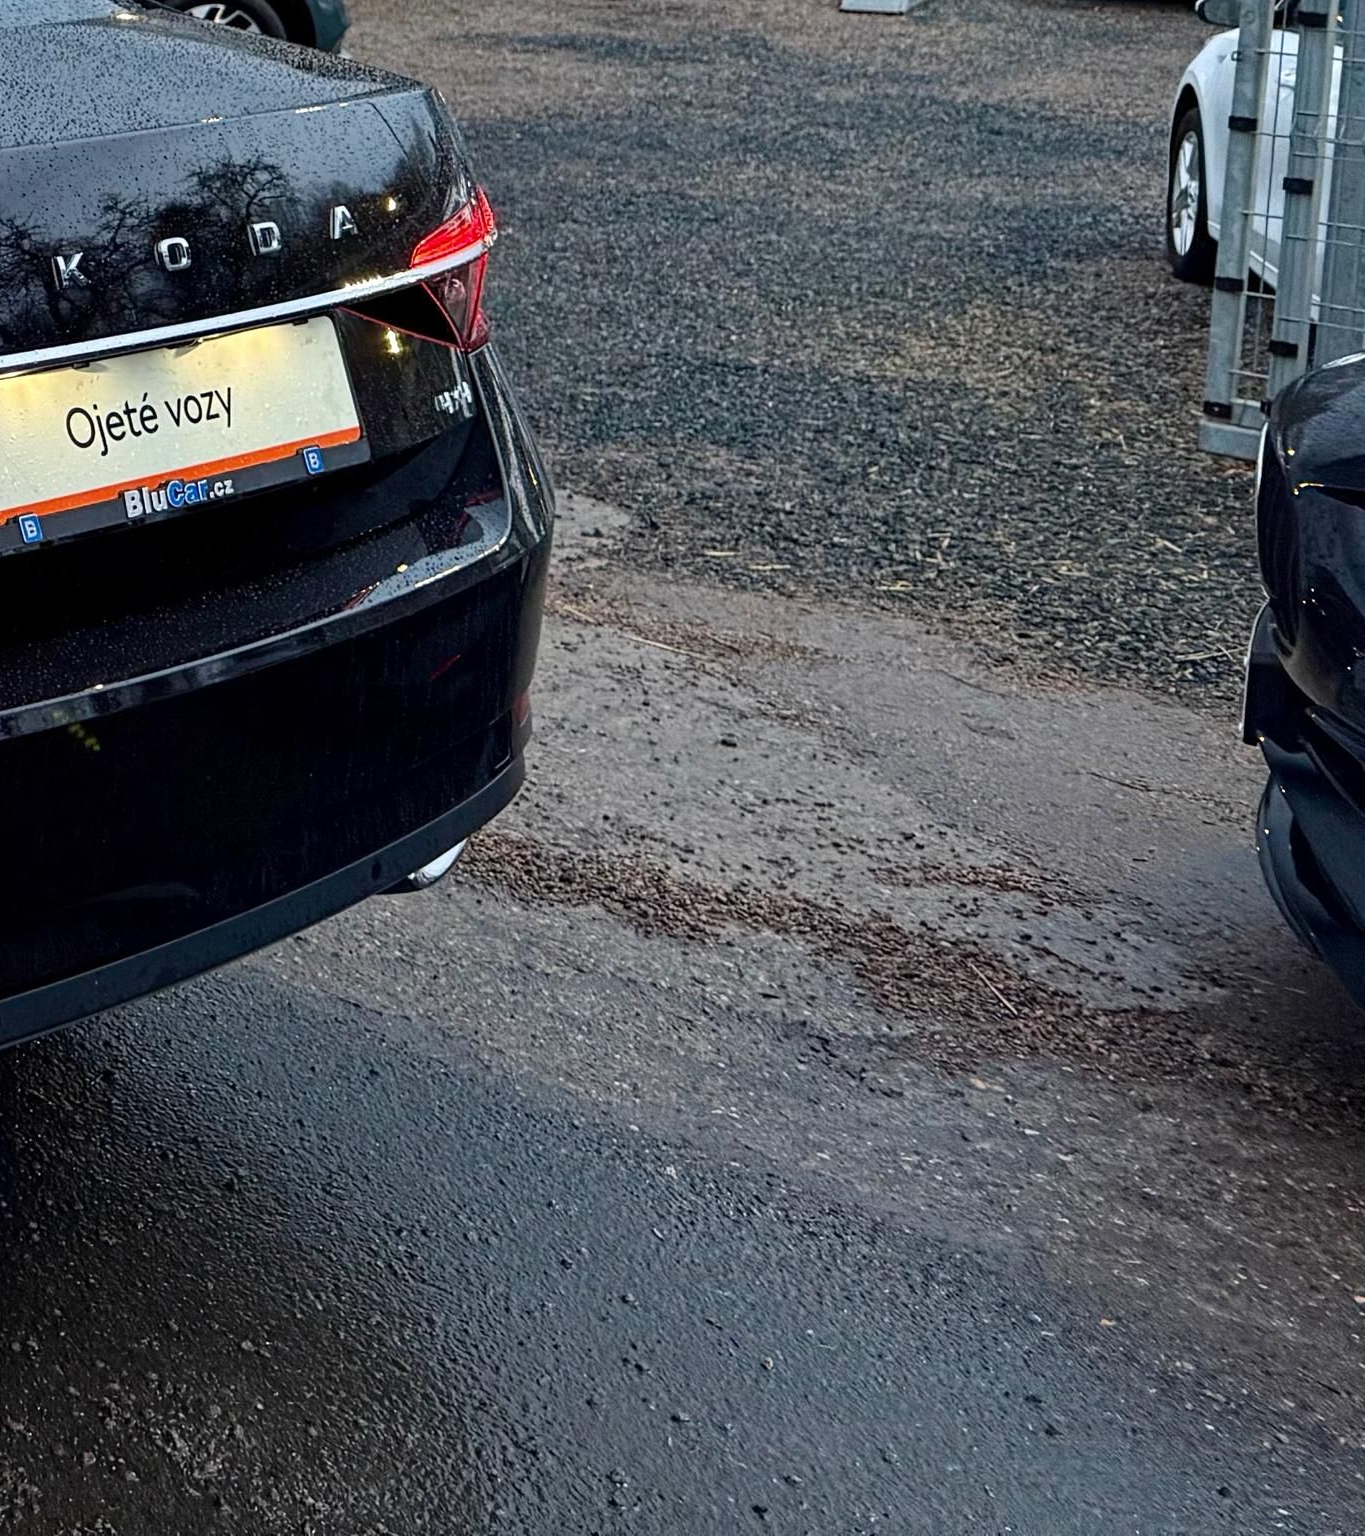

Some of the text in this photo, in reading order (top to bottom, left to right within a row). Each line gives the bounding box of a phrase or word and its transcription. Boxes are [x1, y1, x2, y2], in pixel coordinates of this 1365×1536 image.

[66, 387, 232, 457] Ojeté vozy
[124, 478, 235, 518] BluCar.cz
